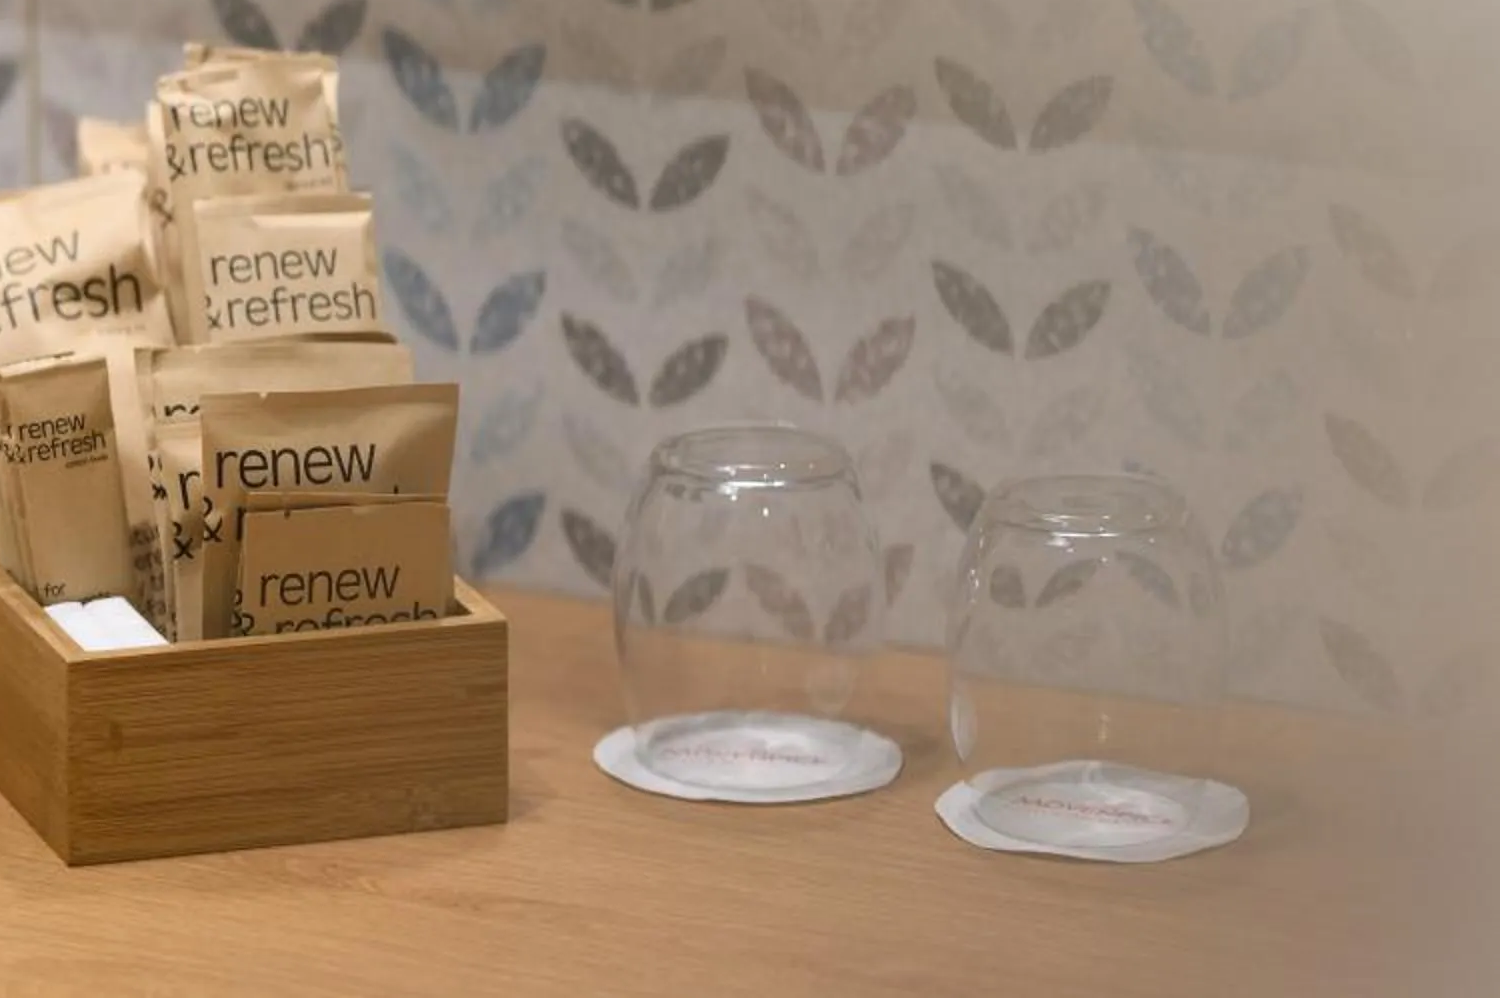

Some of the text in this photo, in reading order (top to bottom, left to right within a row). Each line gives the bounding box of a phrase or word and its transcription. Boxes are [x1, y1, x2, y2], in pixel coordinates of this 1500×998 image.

[170, 95, 290, 132] renew
[211, 248, 337, 285] renew
[18, 414, 85, 440] renew
[216, 444, 376, 489] renew
[260, 565, 400, 607] renew
